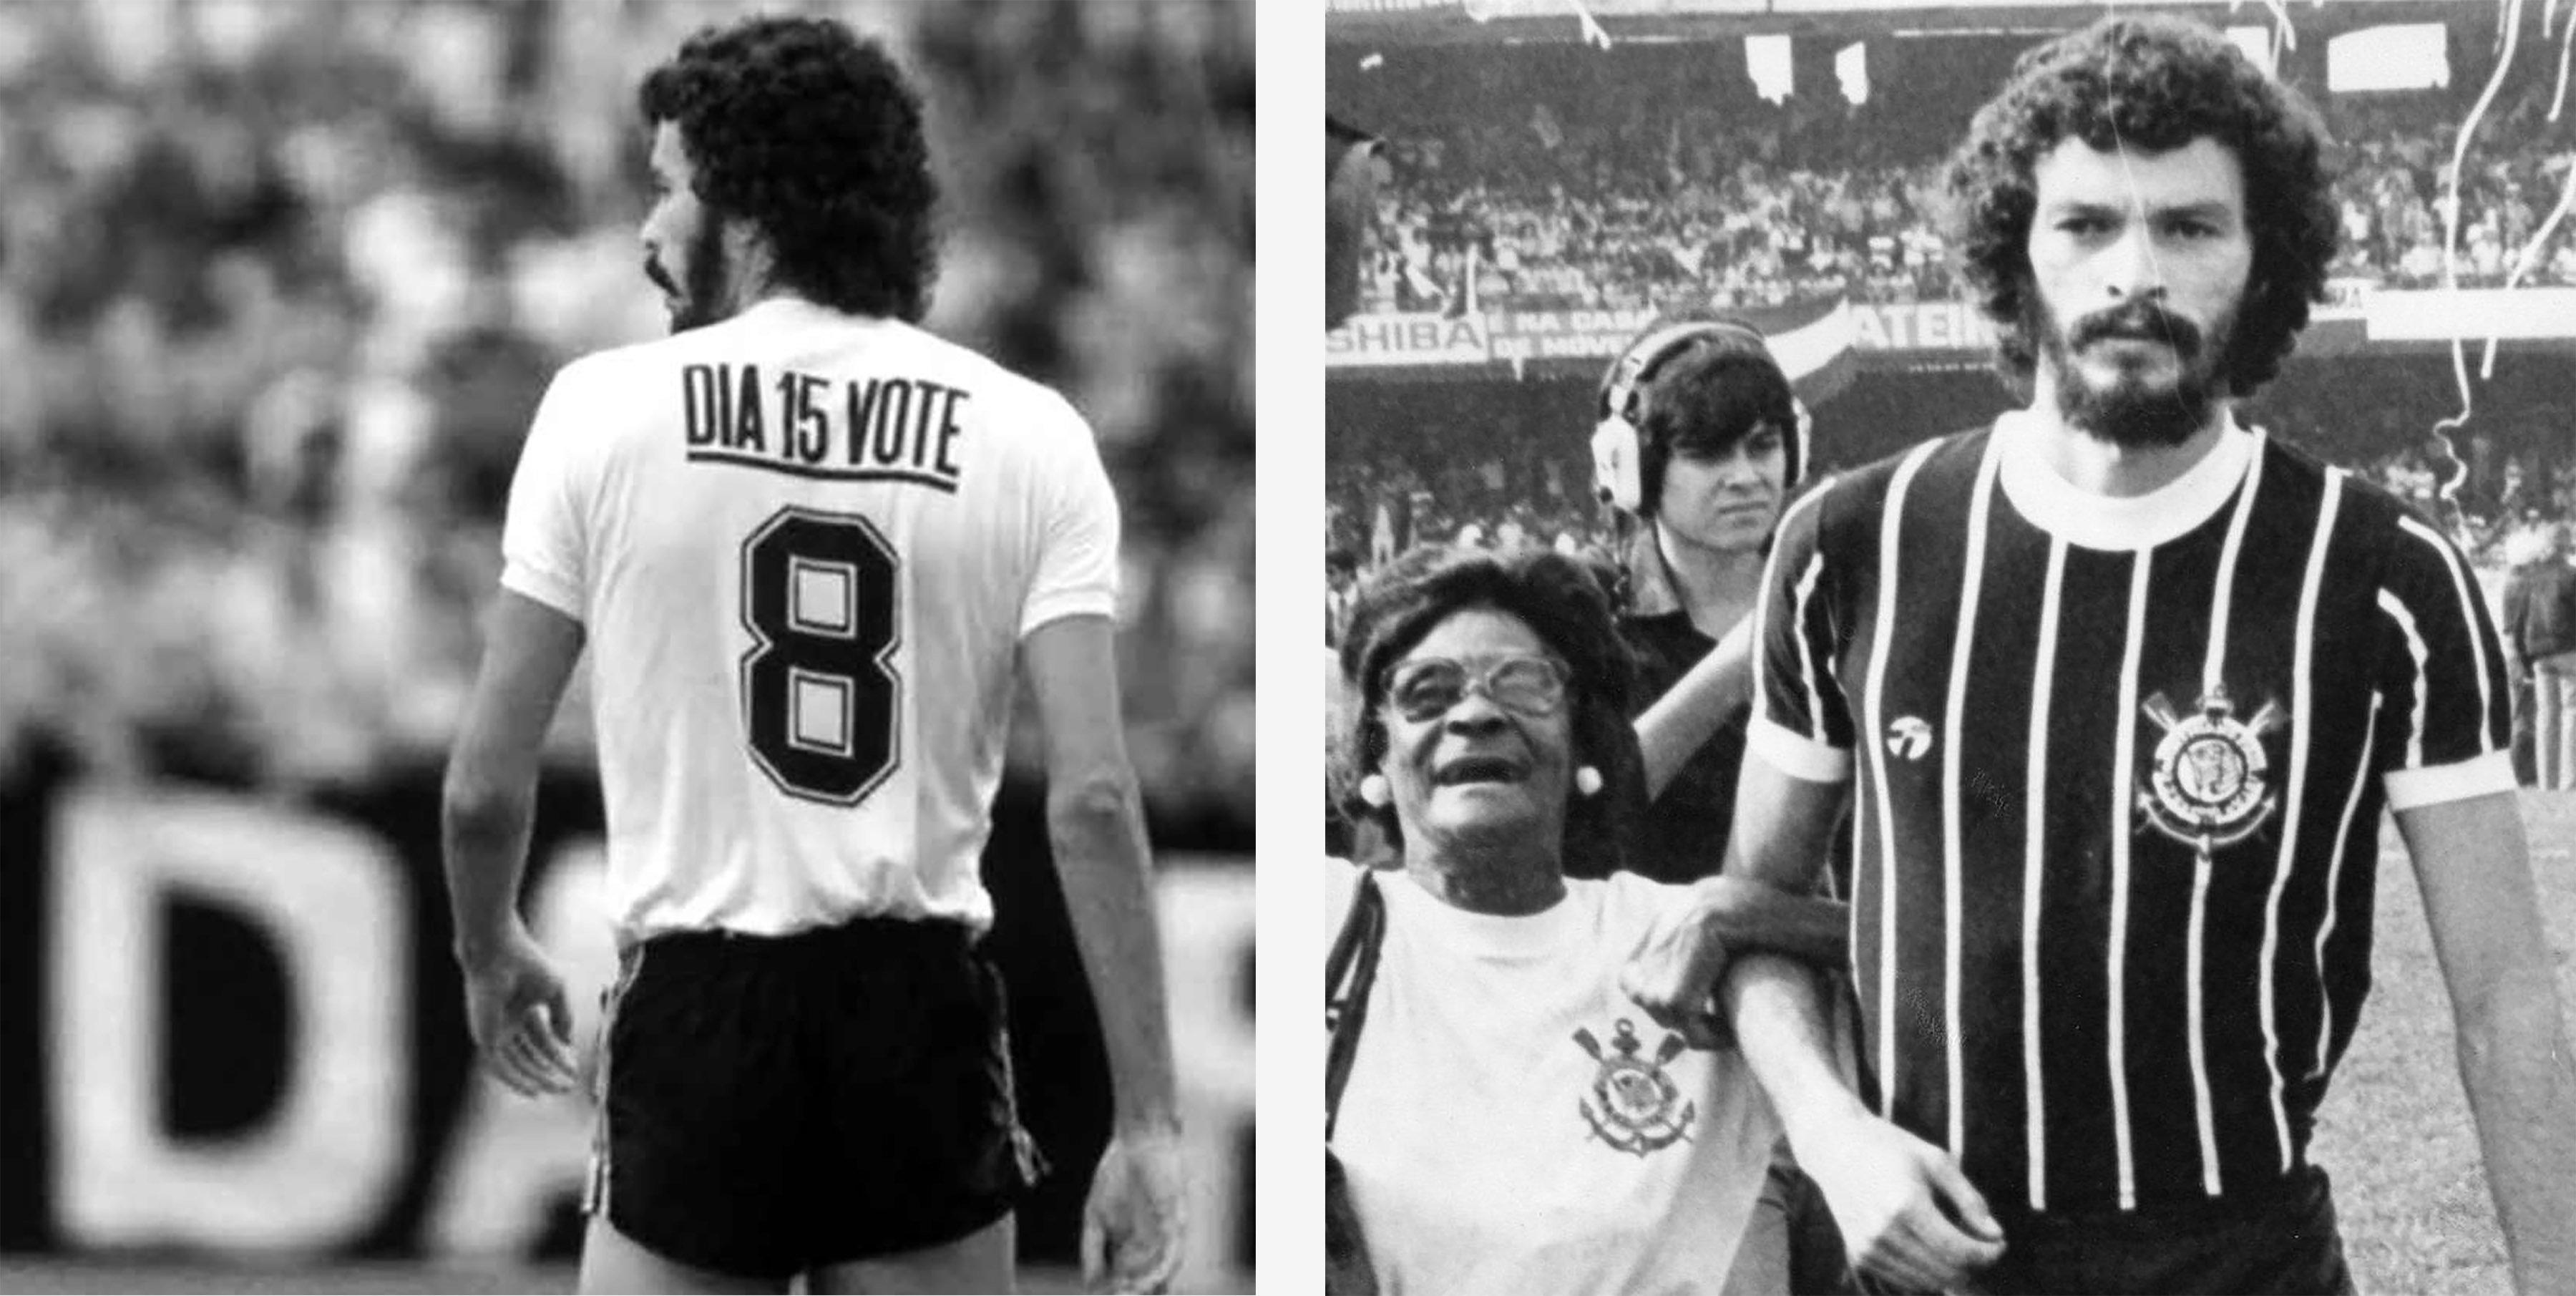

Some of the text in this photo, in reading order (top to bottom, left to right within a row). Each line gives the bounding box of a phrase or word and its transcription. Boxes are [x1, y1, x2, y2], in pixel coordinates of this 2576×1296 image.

[1325, 321, 1483, 352] SHIBA
[683, 363, 970, 477] DIA 15 VOTE
[740, 505, 902, 808] 8
